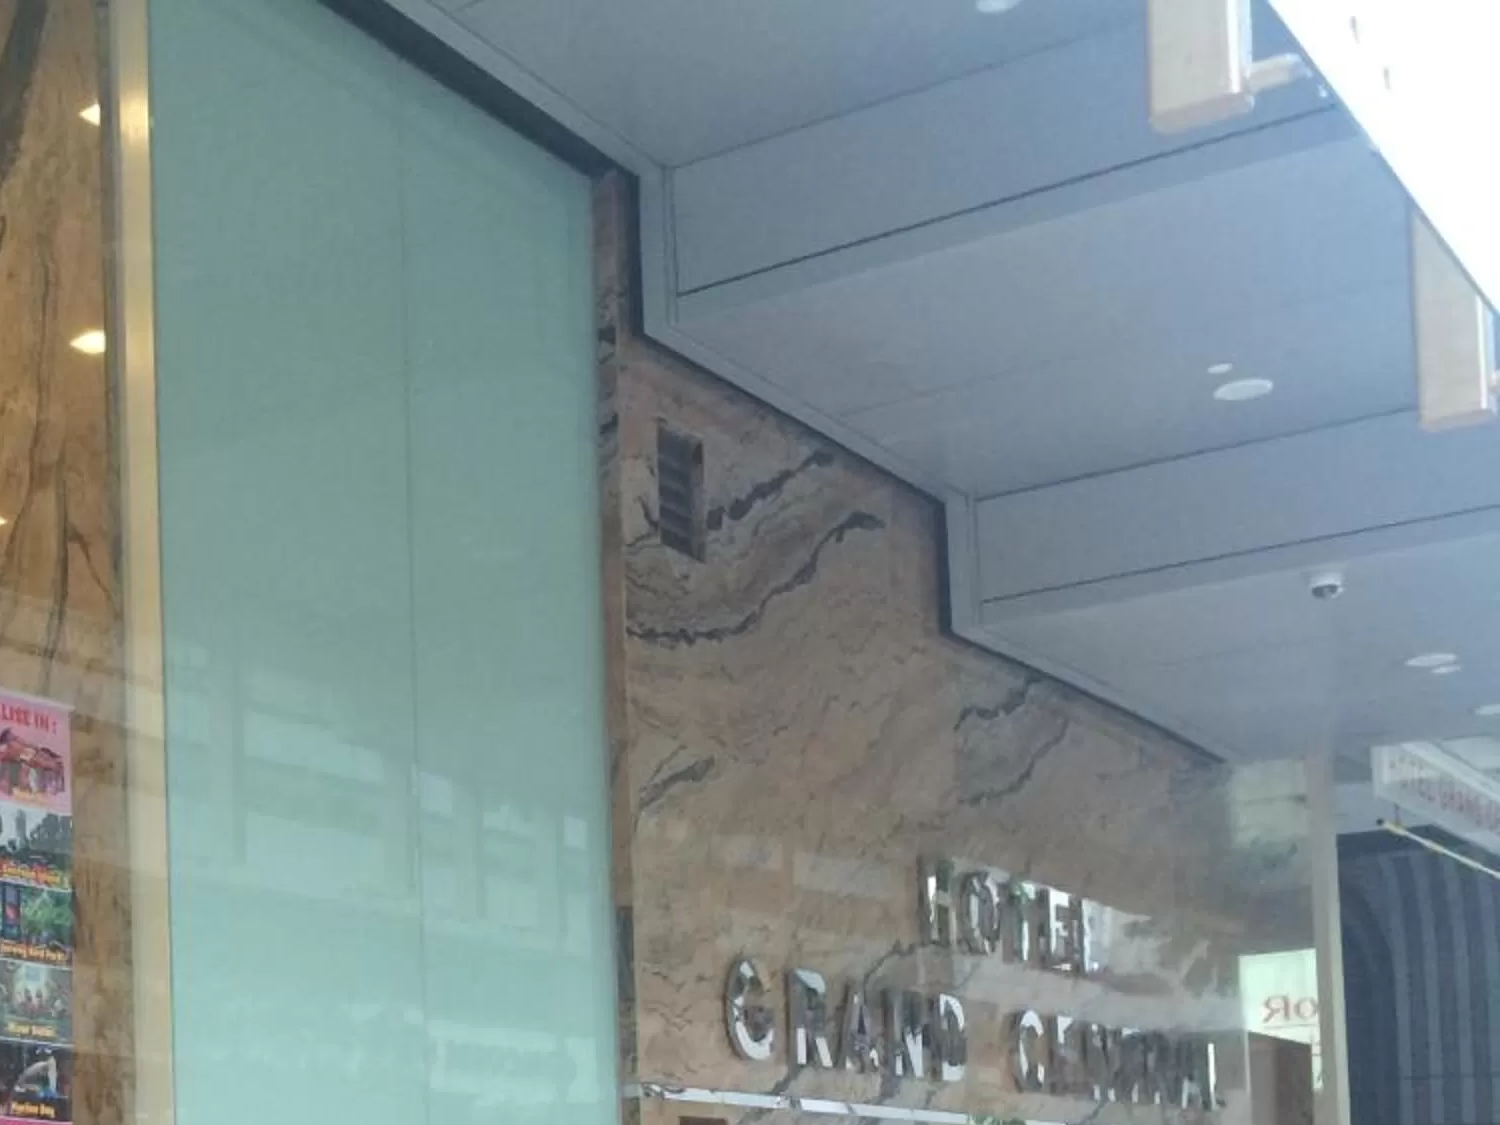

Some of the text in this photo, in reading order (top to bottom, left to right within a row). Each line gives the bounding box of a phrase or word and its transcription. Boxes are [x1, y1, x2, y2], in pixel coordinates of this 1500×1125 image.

[34, 712, 49, 732] IN
[919, 855, 1100, 973] HOTEL
[724, 955, 967, 1083] GRAND
